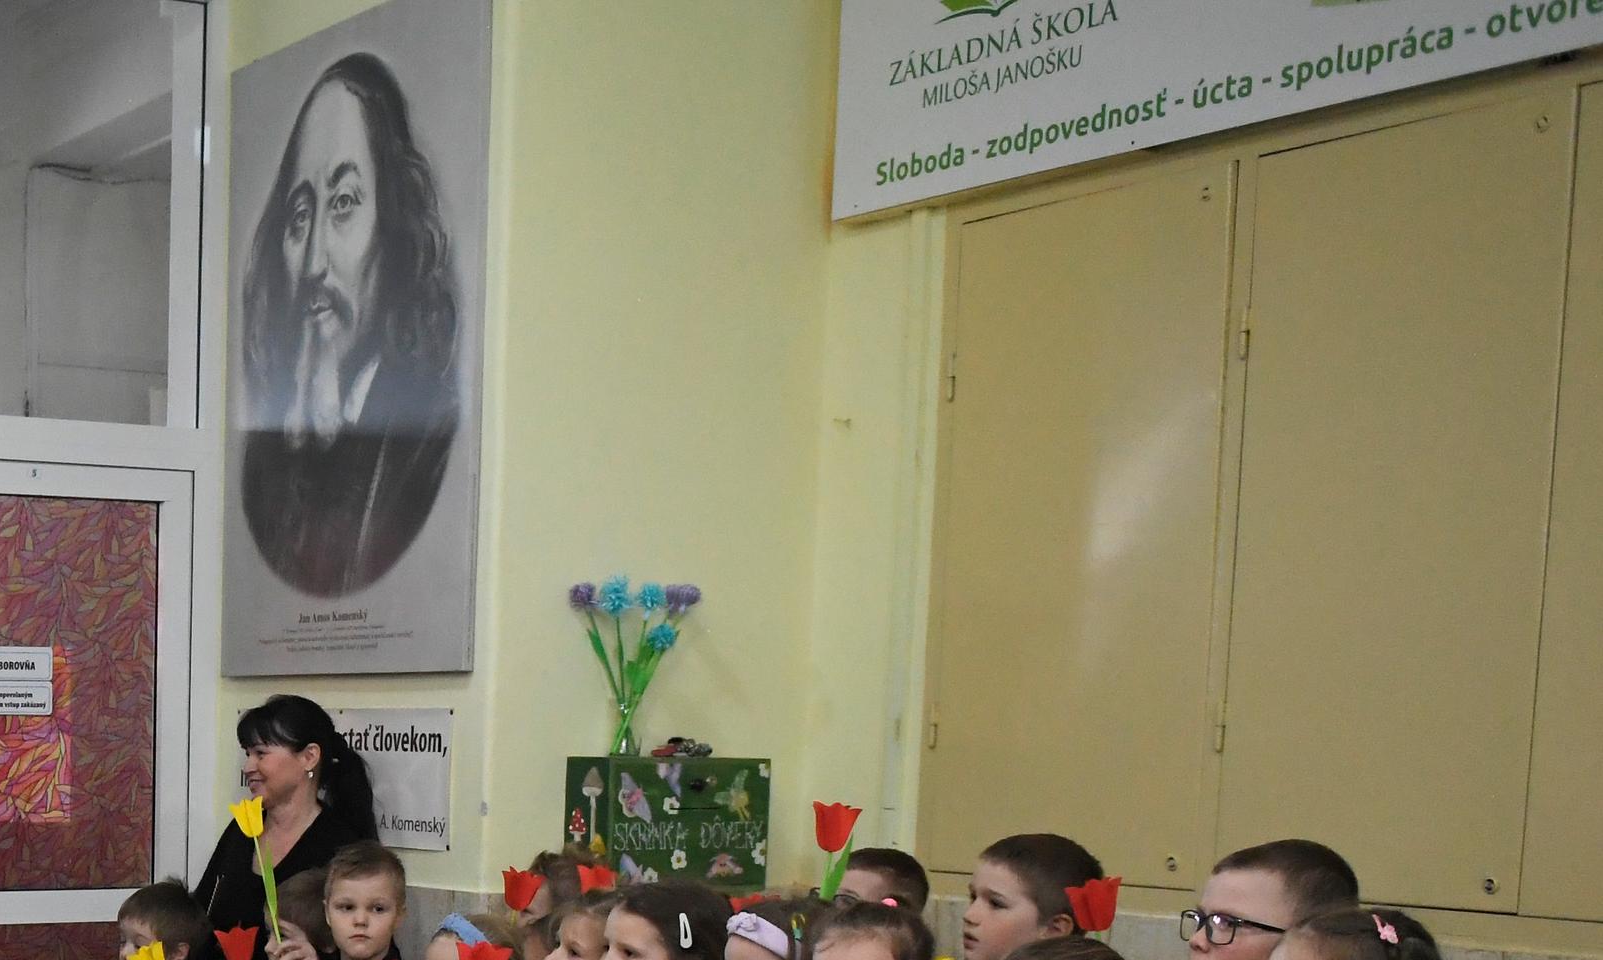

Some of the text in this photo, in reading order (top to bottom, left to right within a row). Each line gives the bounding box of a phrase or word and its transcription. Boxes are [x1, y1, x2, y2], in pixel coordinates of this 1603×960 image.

[889, 0, 1119, 86] ZÁKLADNÁ ŠKOLA
[876, 142, 965, 186] Sloboda
[986, 88, 1167, 154] zodpovednosť
[1193, 78, 1253, 109] úcta
[1280, 26, 1454, 91] spolupráca
[922, 44, 1083, 109] MILOŠA JANOŠKU
[373, 724, 448, 758] človekom,
[391, 815, 446, 838] Komenský
